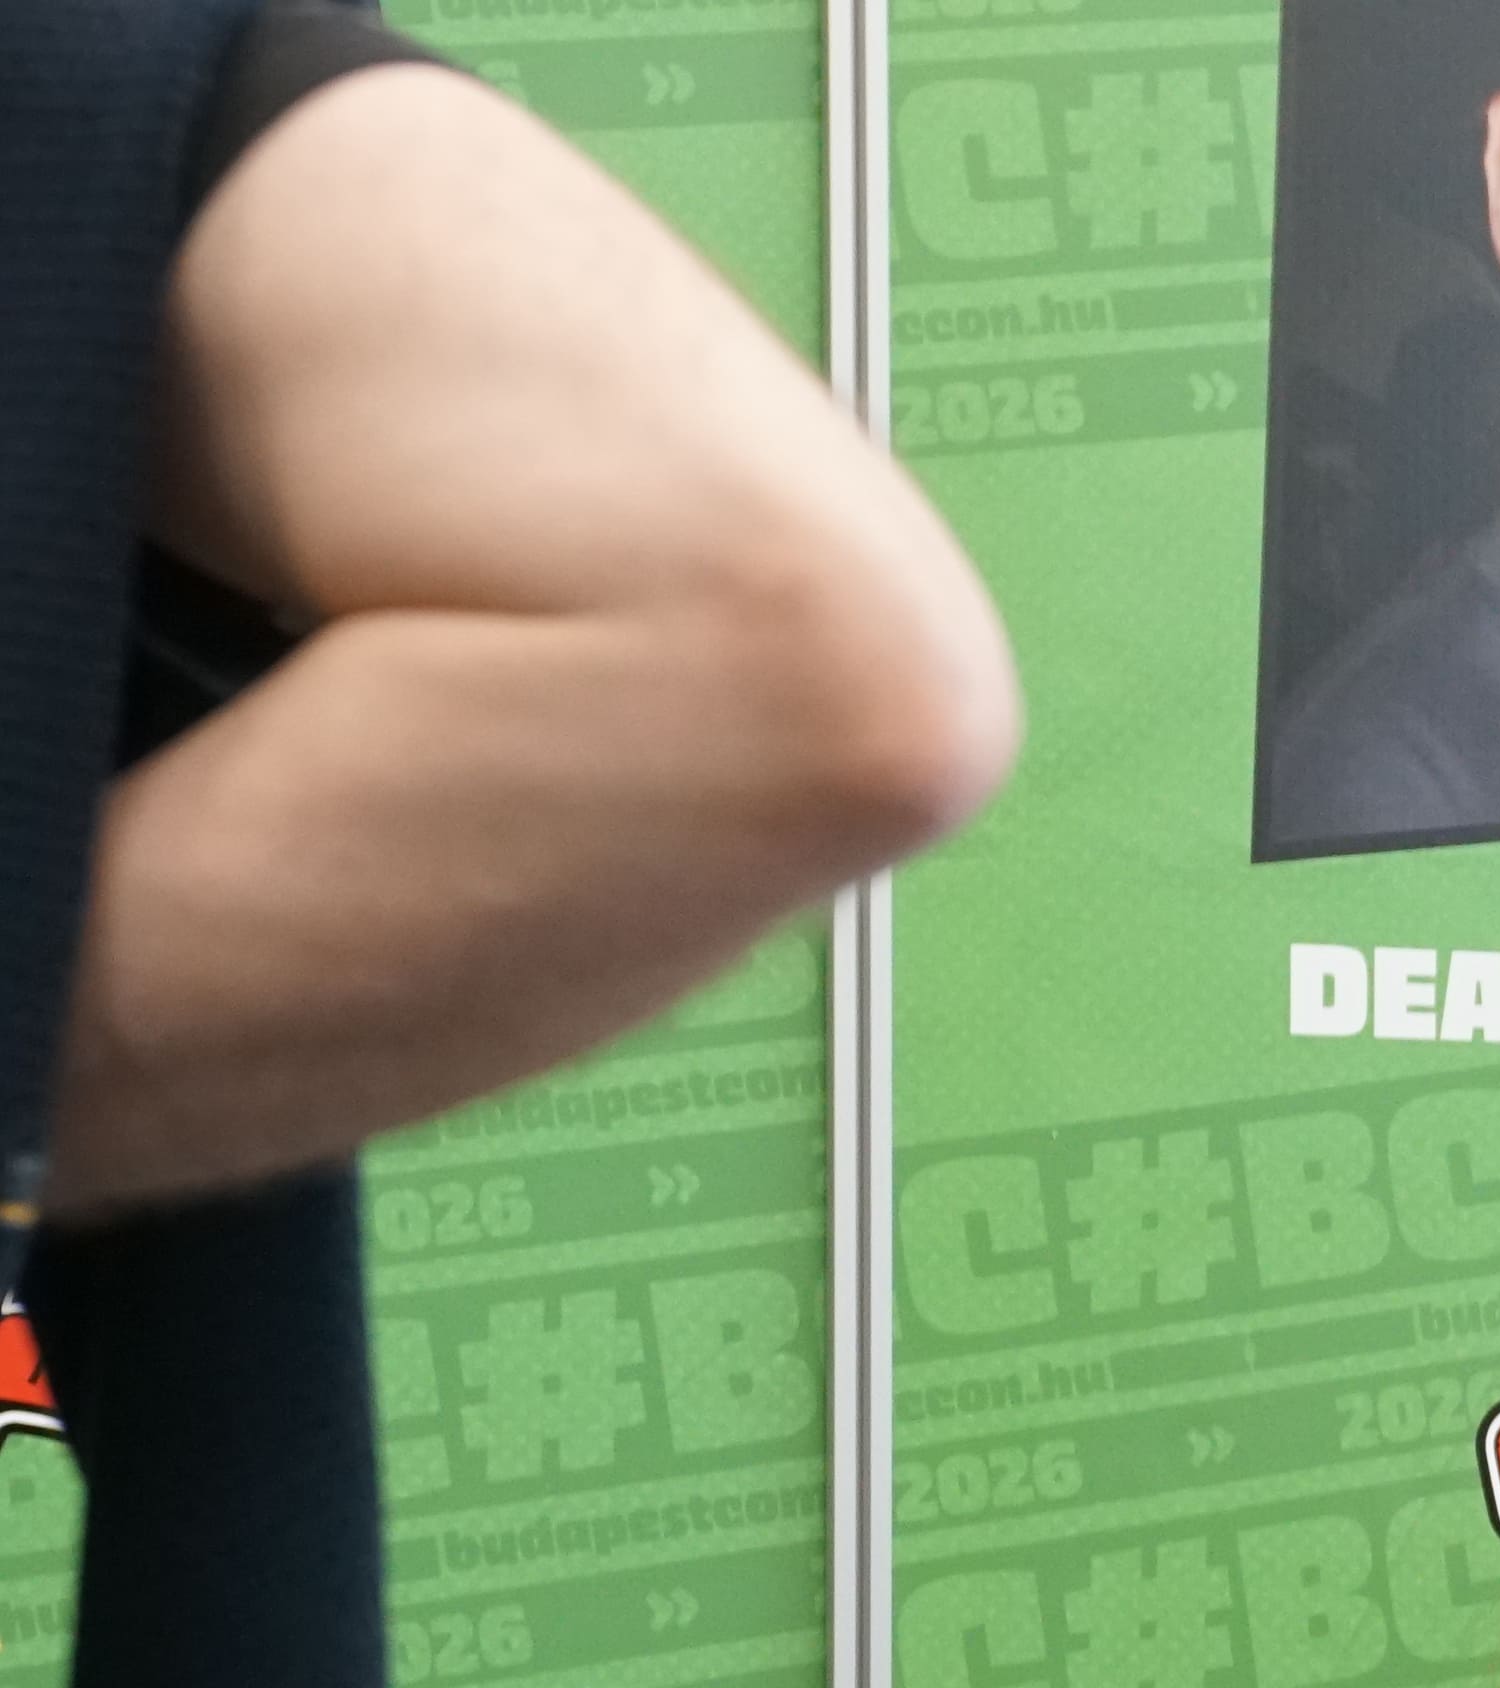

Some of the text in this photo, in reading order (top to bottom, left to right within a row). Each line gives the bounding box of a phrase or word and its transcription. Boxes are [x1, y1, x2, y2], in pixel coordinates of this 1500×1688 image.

[900, 64, 1278, 260] C#
[893, 373, 1086, 449] 2026
[893, 1438, 1083, 1522] 2026
